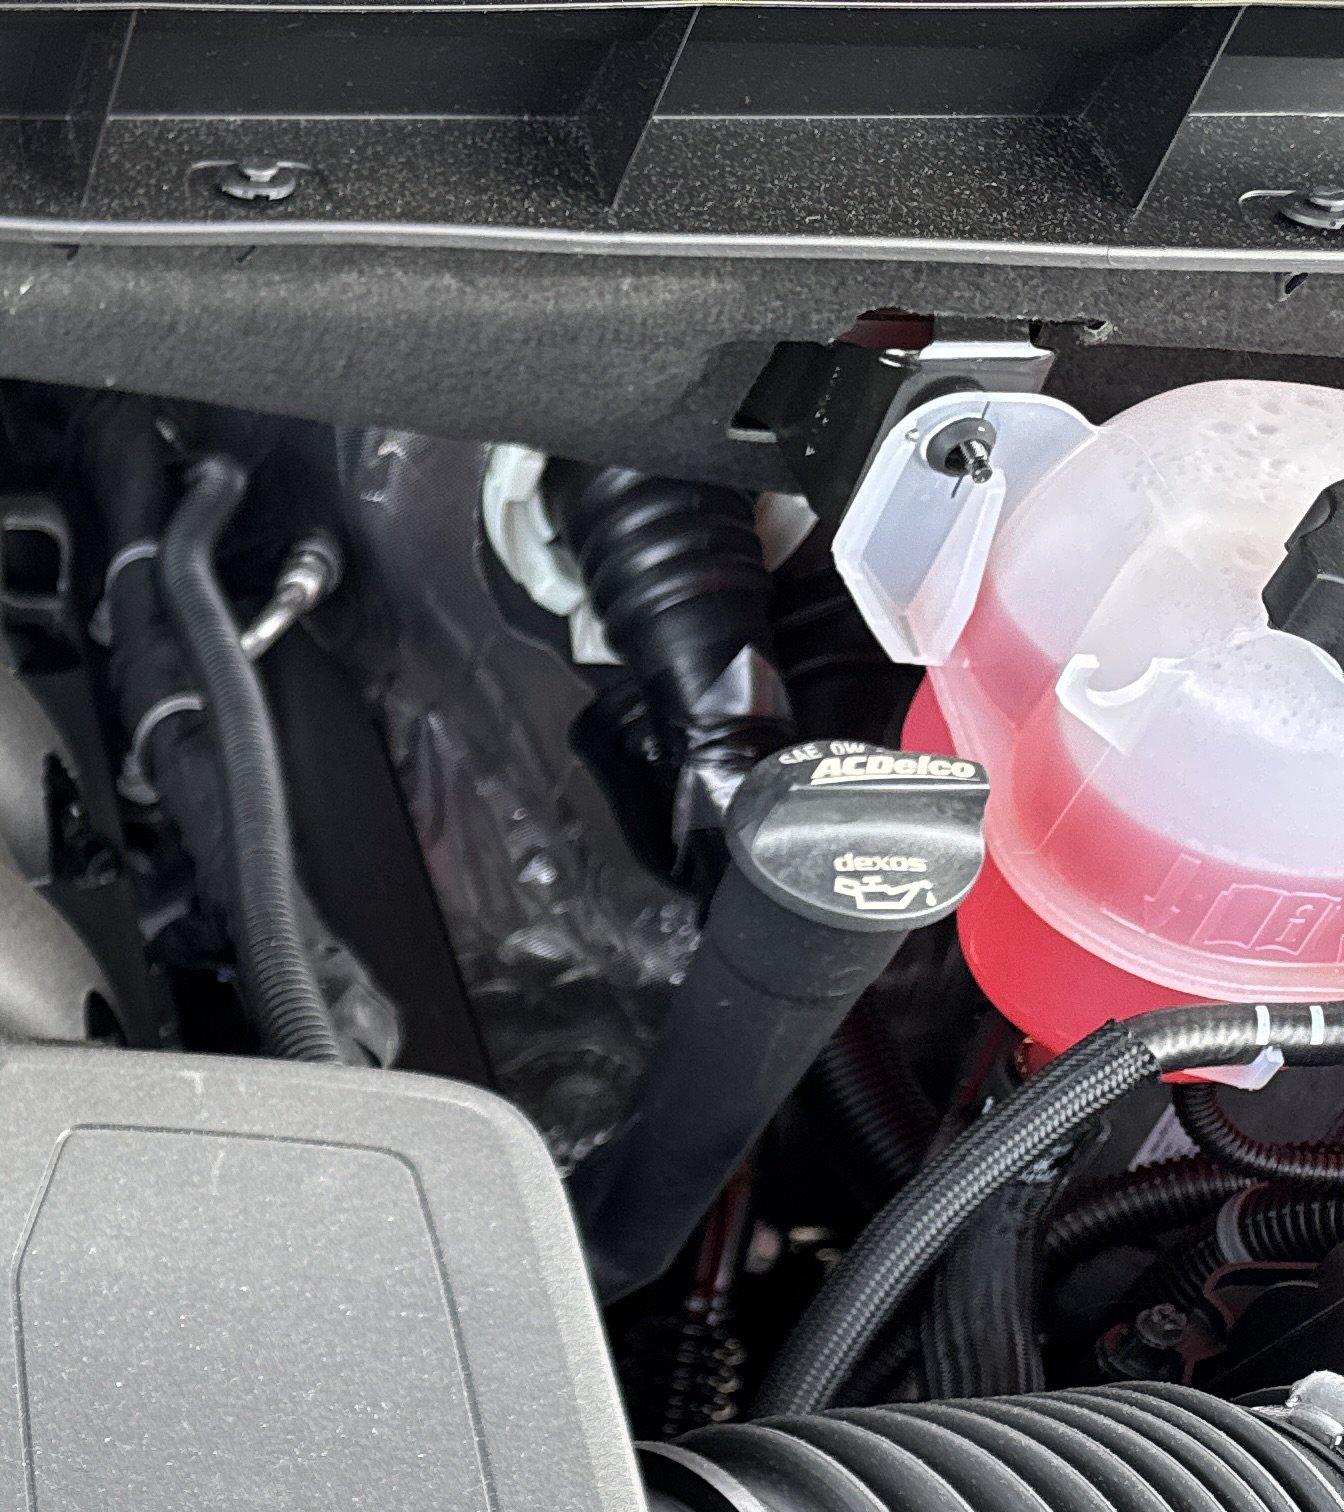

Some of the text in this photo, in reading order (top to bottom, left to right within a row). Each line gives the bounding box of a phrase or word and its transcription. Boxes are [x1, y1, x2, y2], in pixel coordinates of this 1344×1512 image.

[778, 744, 823, 765] SAE
[810, 754, 977, 780] ACDelco
[833, 852, 929, 872] dexos
